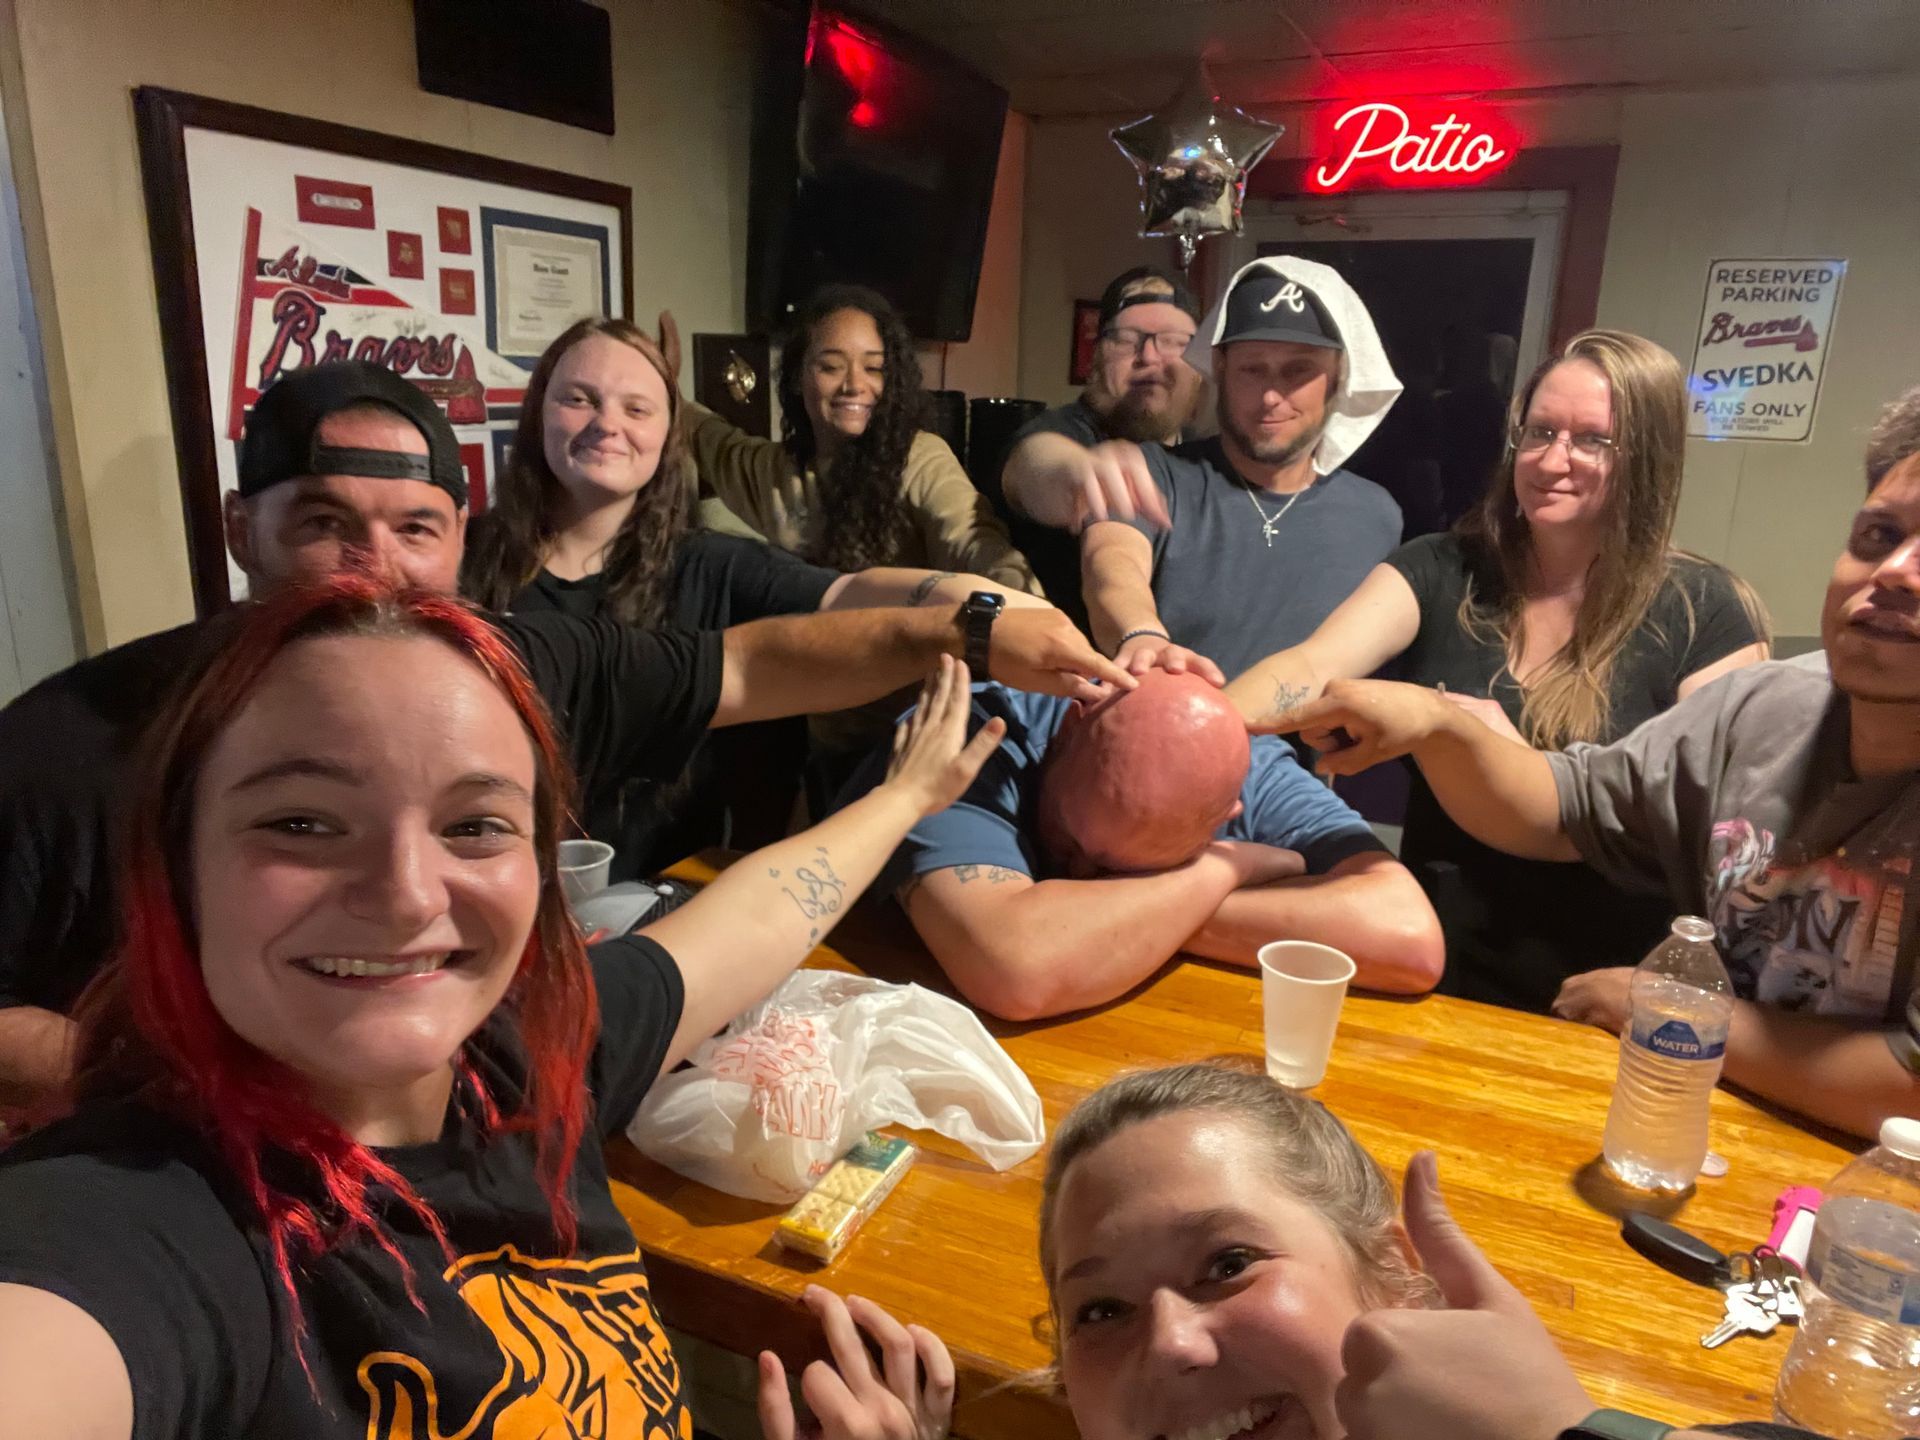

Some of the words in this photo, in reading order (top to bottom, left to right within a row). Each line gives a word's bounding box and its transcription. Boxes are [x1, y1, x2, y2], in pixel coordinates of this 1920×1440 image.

[1317, 103, 1505, 187] Patio
[1716, 269, 1834, 285] RESERVED
[1721, 287, 1821, 303] PARKING
[1703, 312, 1804, 347] Braves
[1702, 361, 1814, 392] SVEDKA
[1693, 401, 1746, 417] FANS
[1751, 402, 1808, 418] ONLY
[1652, 1035, 1700, 1054] WATER
